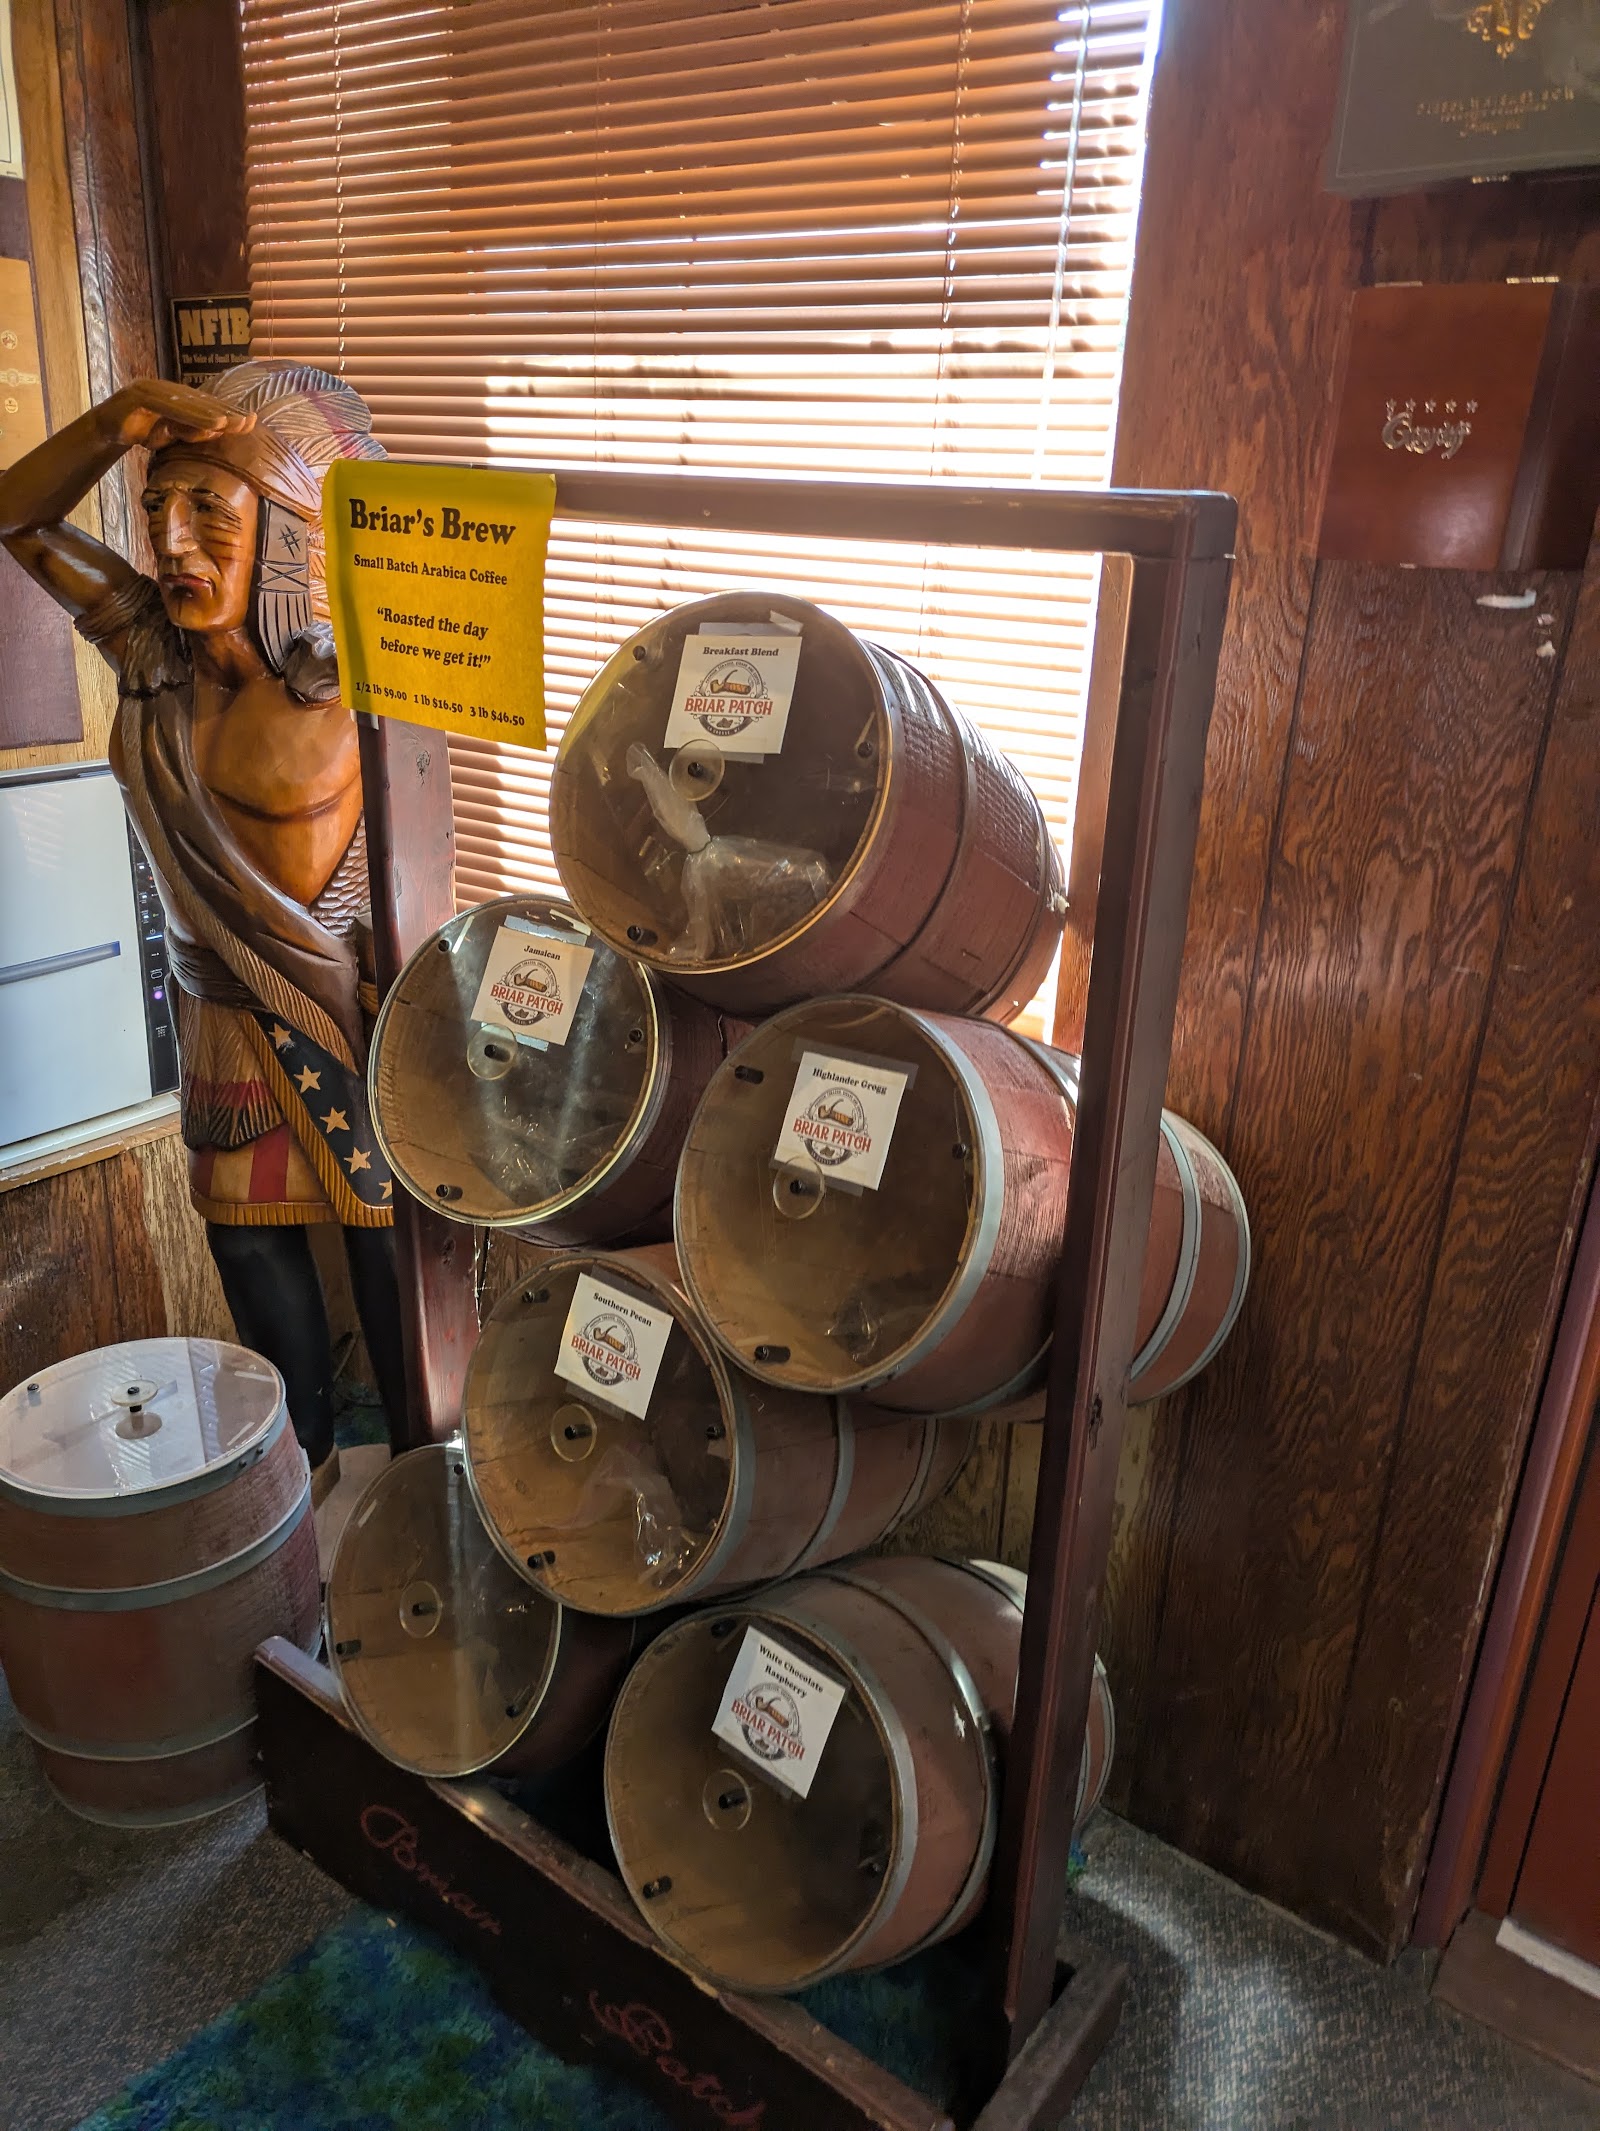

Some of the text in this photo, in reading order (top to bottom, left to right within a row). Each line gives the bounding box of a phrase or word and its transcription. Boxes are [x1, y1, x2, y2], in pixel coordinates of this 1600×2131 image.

[178, 307, 251, 347] NFIB
[349, 498, 516, 545] Briar's Brew
[354, 554, 508, 586] Small Batch Arabica Coffee
[438, 616, 460, 634] the
[463, 621, 489, 641] day
[380, 637, 419, 657] before
[422, 646, 442, 661] we
[443, 650, 465, 666] get
[703, 647, 779, 656] Breakfast Blend
[355, 681, 525, 727] 1/2 lb $9.00 1 lb $16.50 3 lb $46.50
[684, 697, 773, 715] BRIAR PATCH
[524, 945, 561, 961] Jamaican
[490, 984, 564, 1015] BRIAR PATCH
[812, 1067, 860, 1087] Highlander
[793, 1117, 872, 1153] BRIAR PATCH
[593, 1292, 652, 1327] Southern Pecan
[571, 1335, 604, 1361] BRIAR
[605, 1351, 641, 1381] PATCH
[759, 1644, 824, 1694] White Chocolate
[764, 1665, 808, 1699] Raspberry
[731, 1699, 767, 1733] BRIAR
[767, 1726, 806, 1762] PATCH
